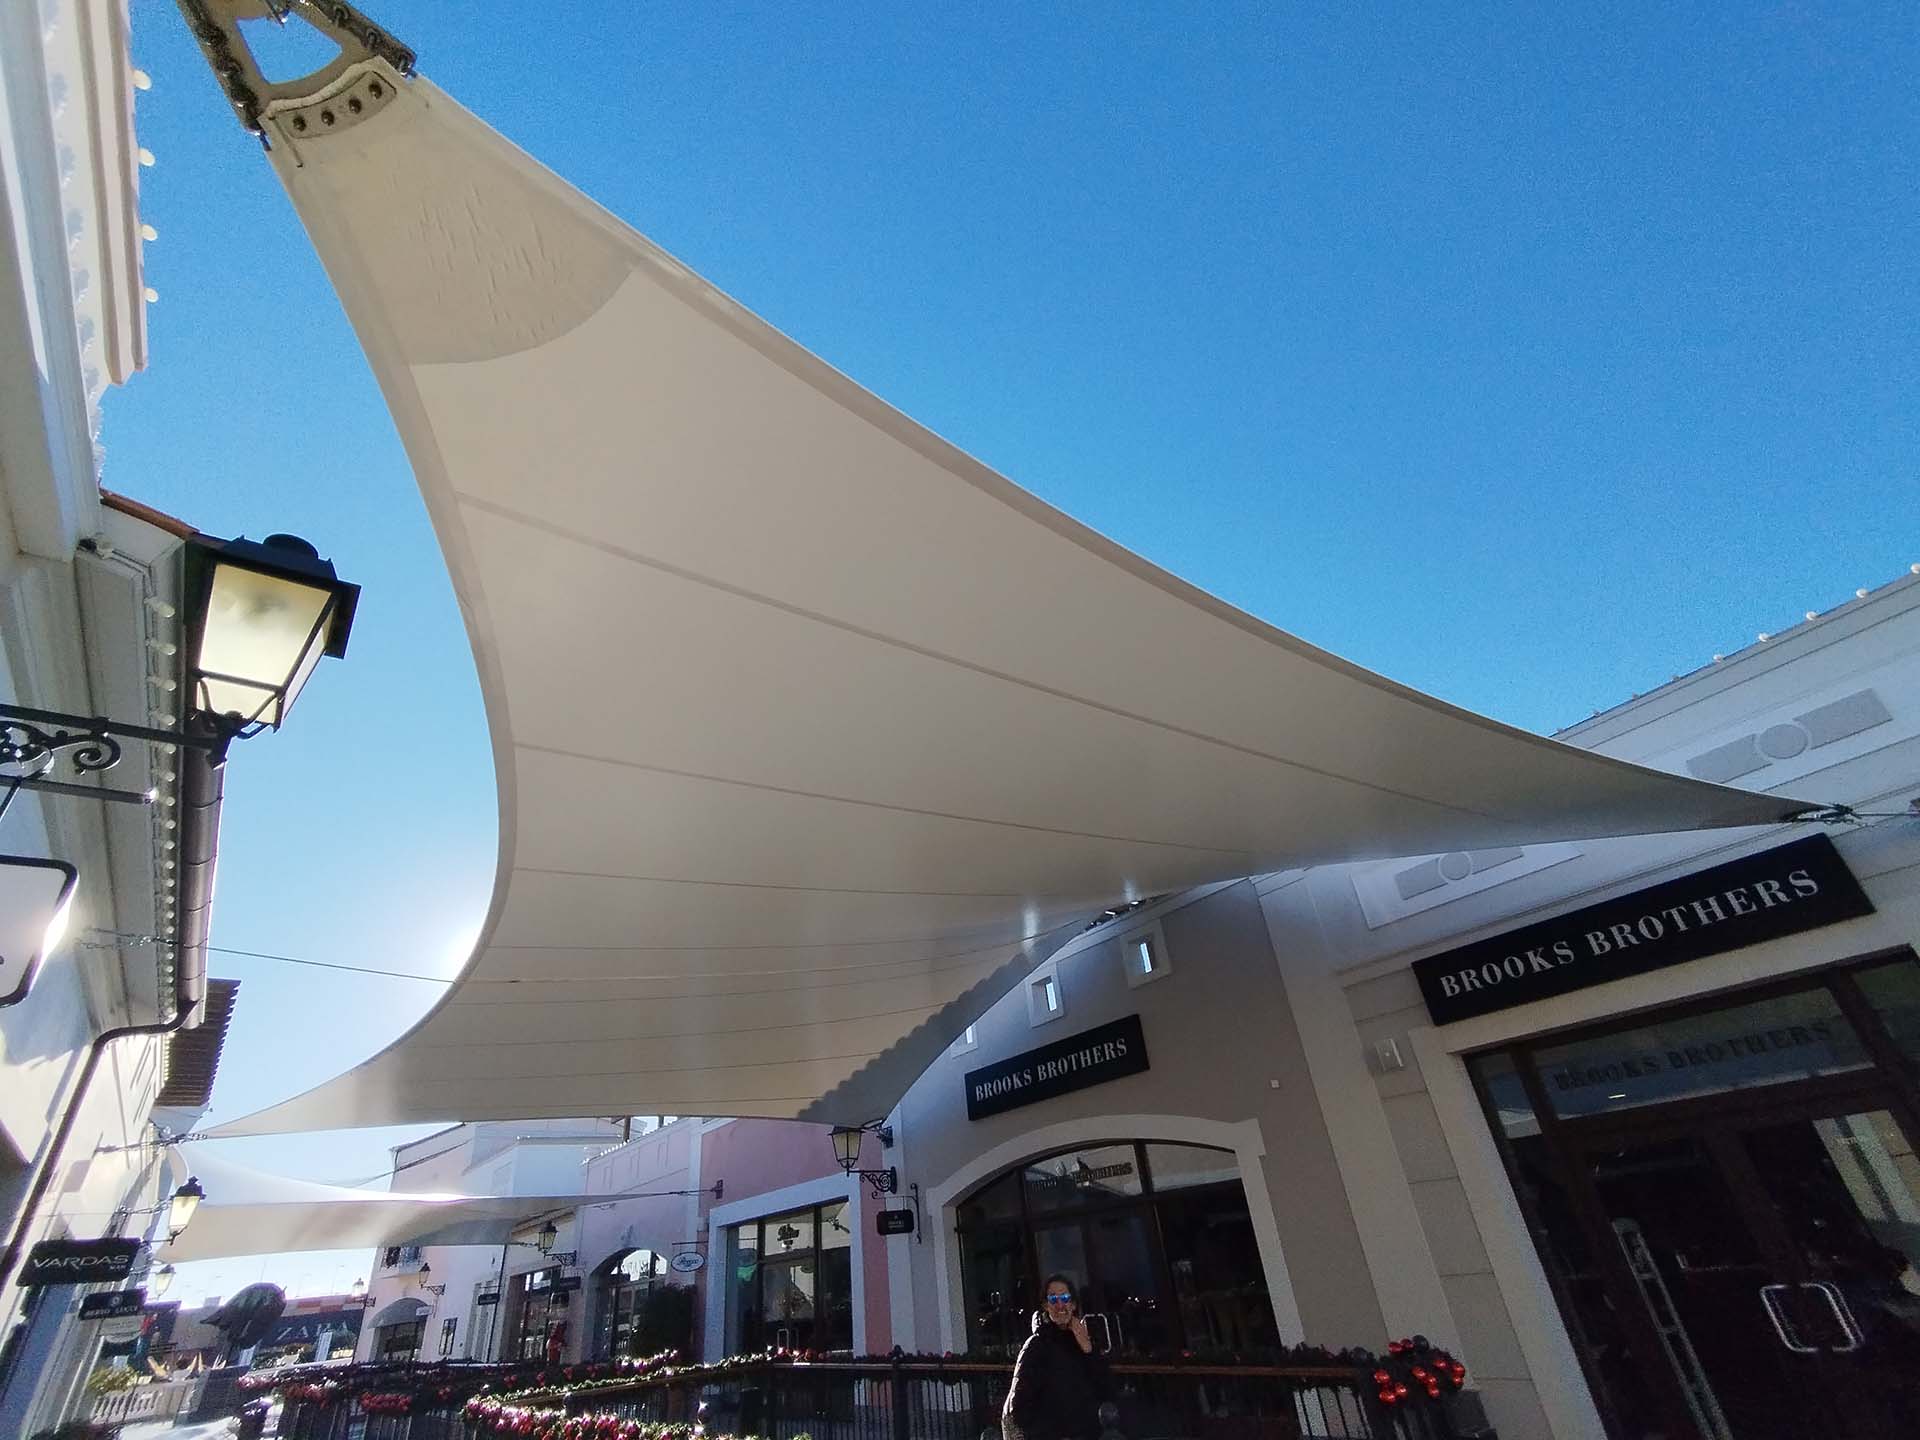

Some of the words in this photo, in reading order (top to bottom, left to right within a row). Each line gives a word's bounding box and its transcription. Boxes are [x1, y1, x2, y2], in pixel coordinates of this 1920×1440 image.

[1440, 941, 1576, 997] BROOKS
[1585, 869, 1821, 956] BROTHERS
[975, 1068, 1032, 1102] BROOKS
[1037, 1038, 1129, 1081] BROTHERS
[1664, 1019, 1832, 1069] BROTHERS
[33, 1254, 129, 1270] VARDAS
